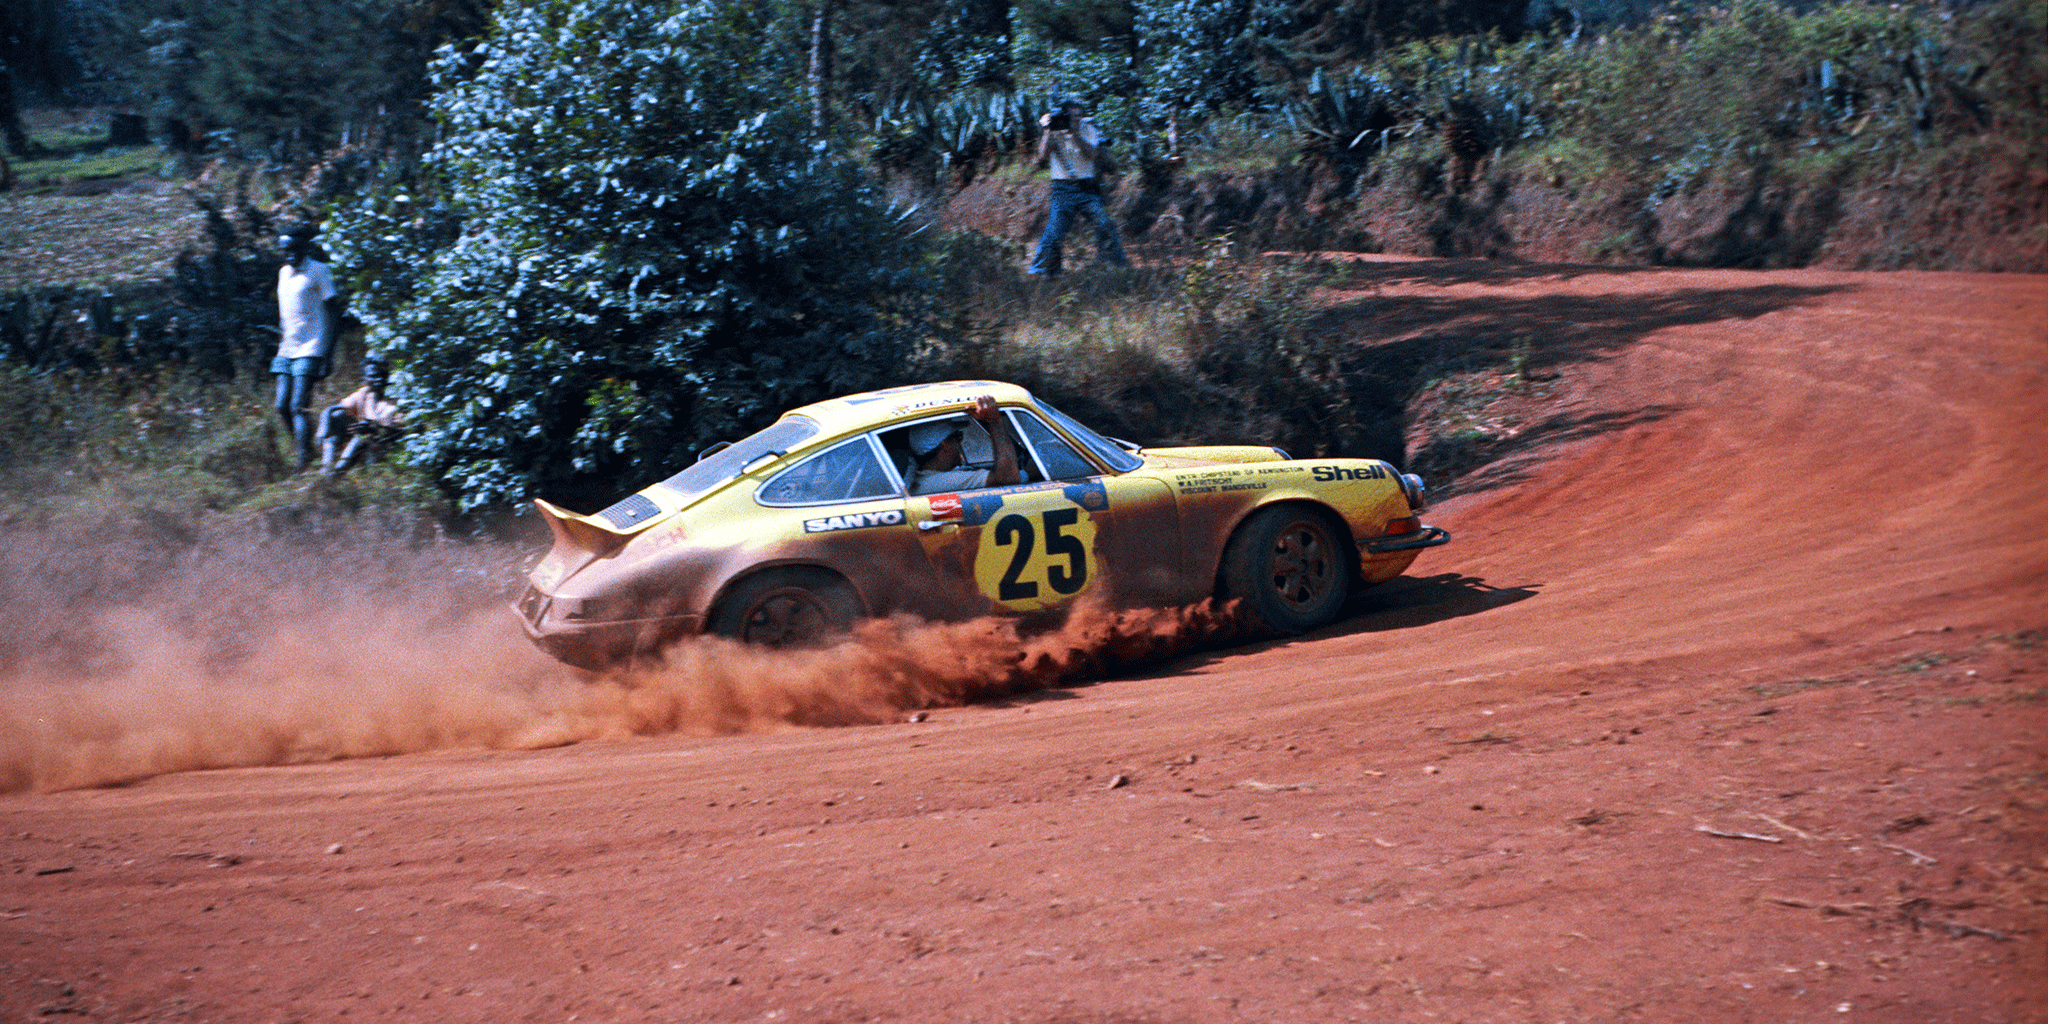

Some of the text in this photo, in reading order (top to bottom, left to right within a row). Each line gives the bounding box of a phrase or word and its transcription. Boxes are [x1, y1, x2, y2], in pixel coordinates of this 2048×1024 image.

[914, 396, 978, 409] DUNLO
[1312, 464, 1386, 481] Shell
[806, 510, 902, 532] SANYO
[994, 507, 1087, 601] 25
